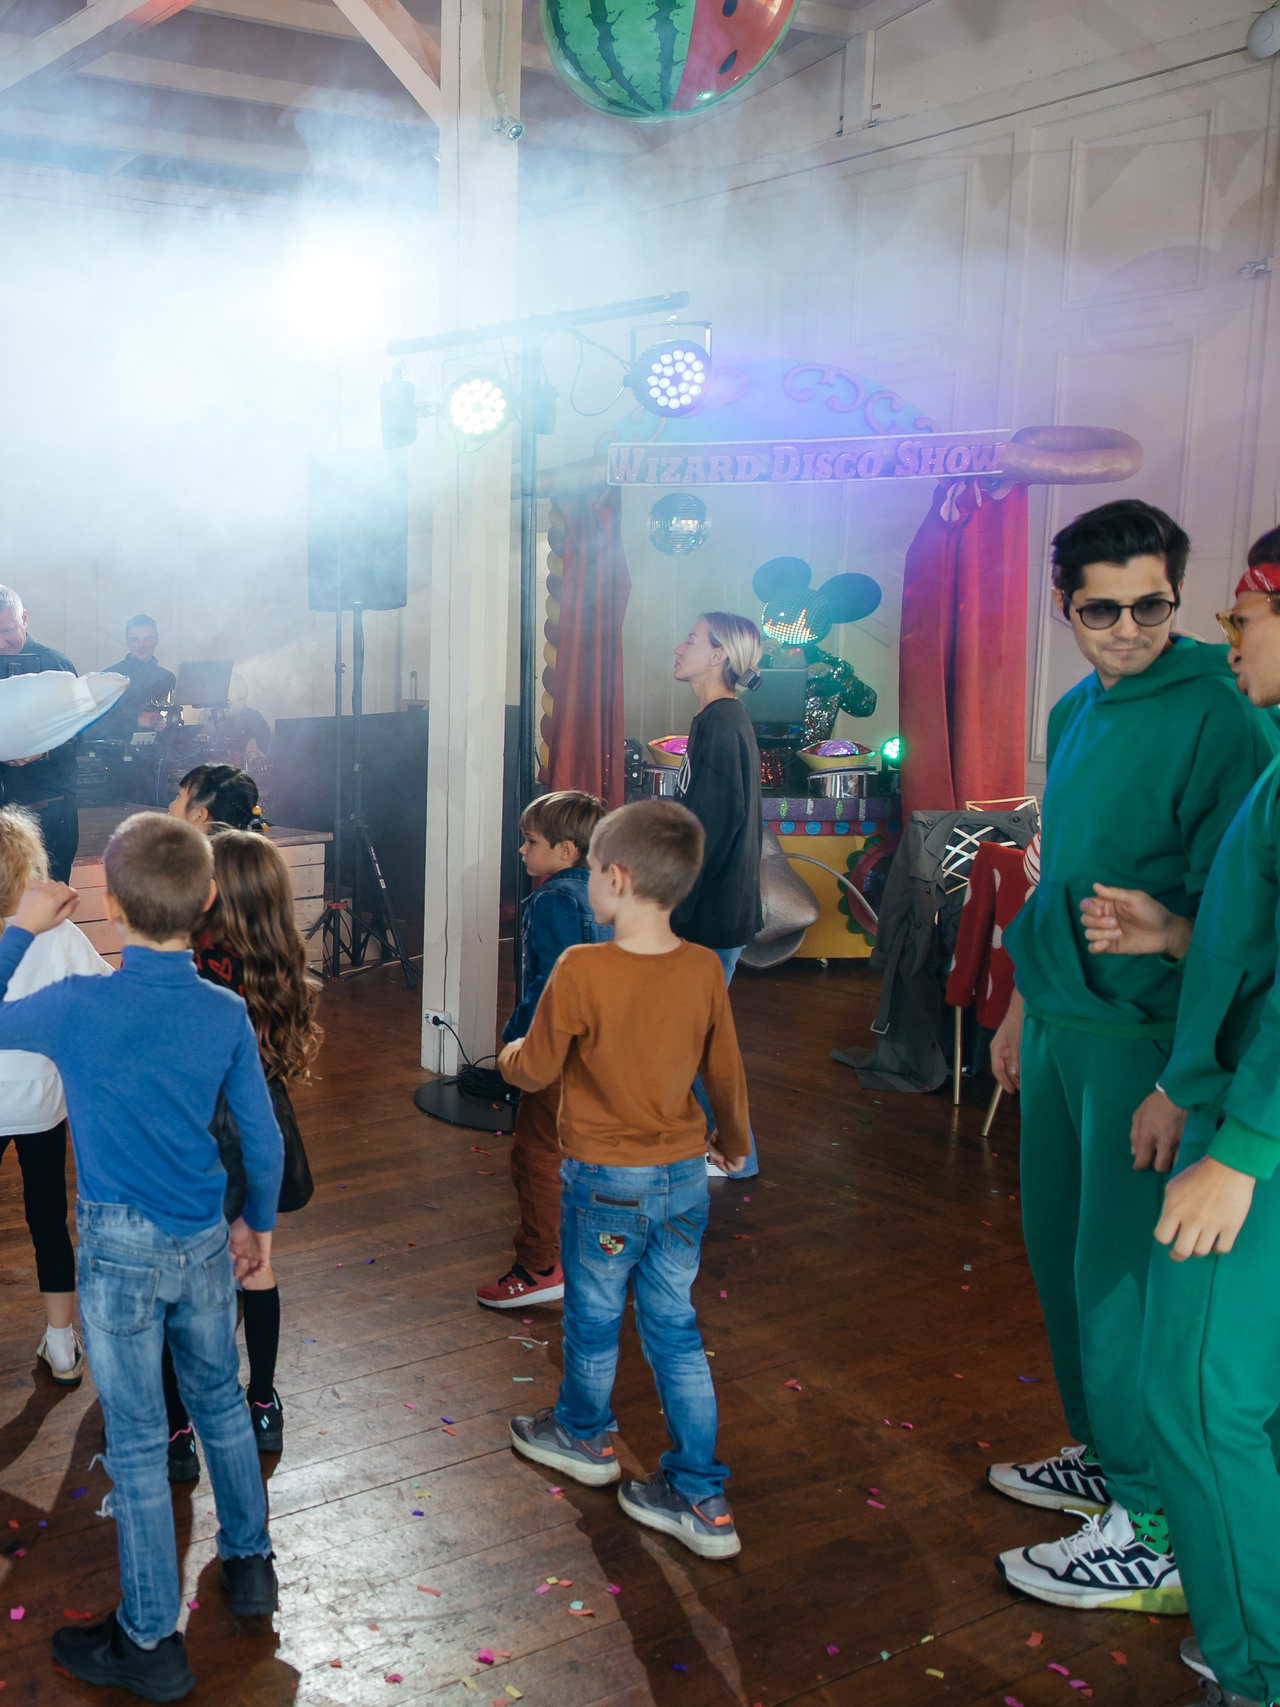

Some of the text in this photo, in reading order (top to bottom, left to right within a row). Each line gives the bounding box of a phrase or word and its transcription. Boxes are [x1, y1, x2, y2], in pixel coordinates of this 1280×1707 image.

[609, 440, 1007, 483] WIZARD DISCO SHOW
